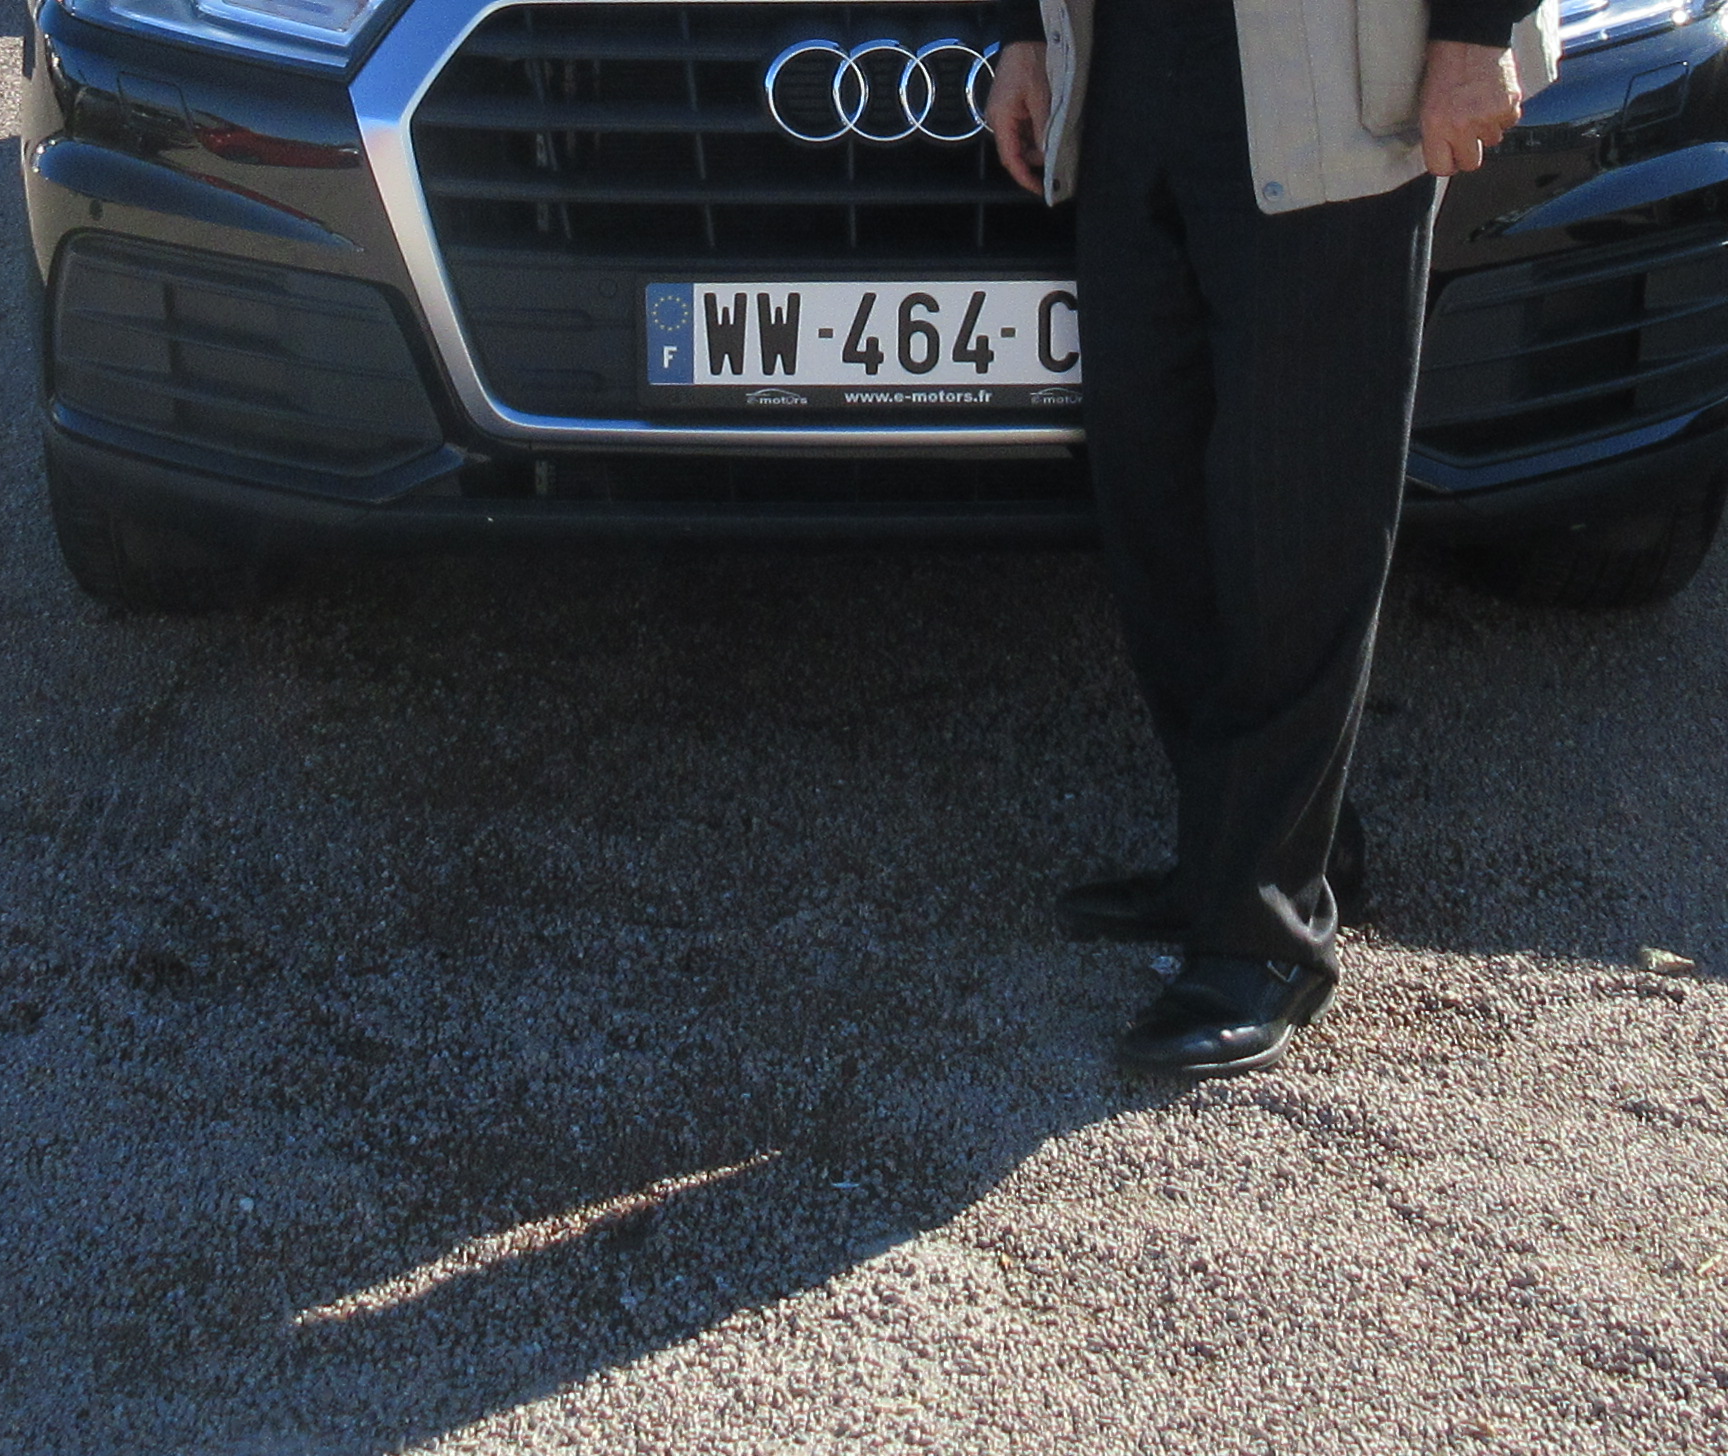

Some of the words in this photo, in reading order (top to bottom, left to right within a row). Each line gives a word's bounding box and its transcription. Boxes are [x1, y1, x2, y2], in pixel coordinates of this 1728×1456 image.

[704, 290, 1079, 376] WW-464-C
[663, 345, 677, 369] F
[844, 389, 993, 405] www.e-motors.fr
[1030, 394, 1083, 405] e-motor
